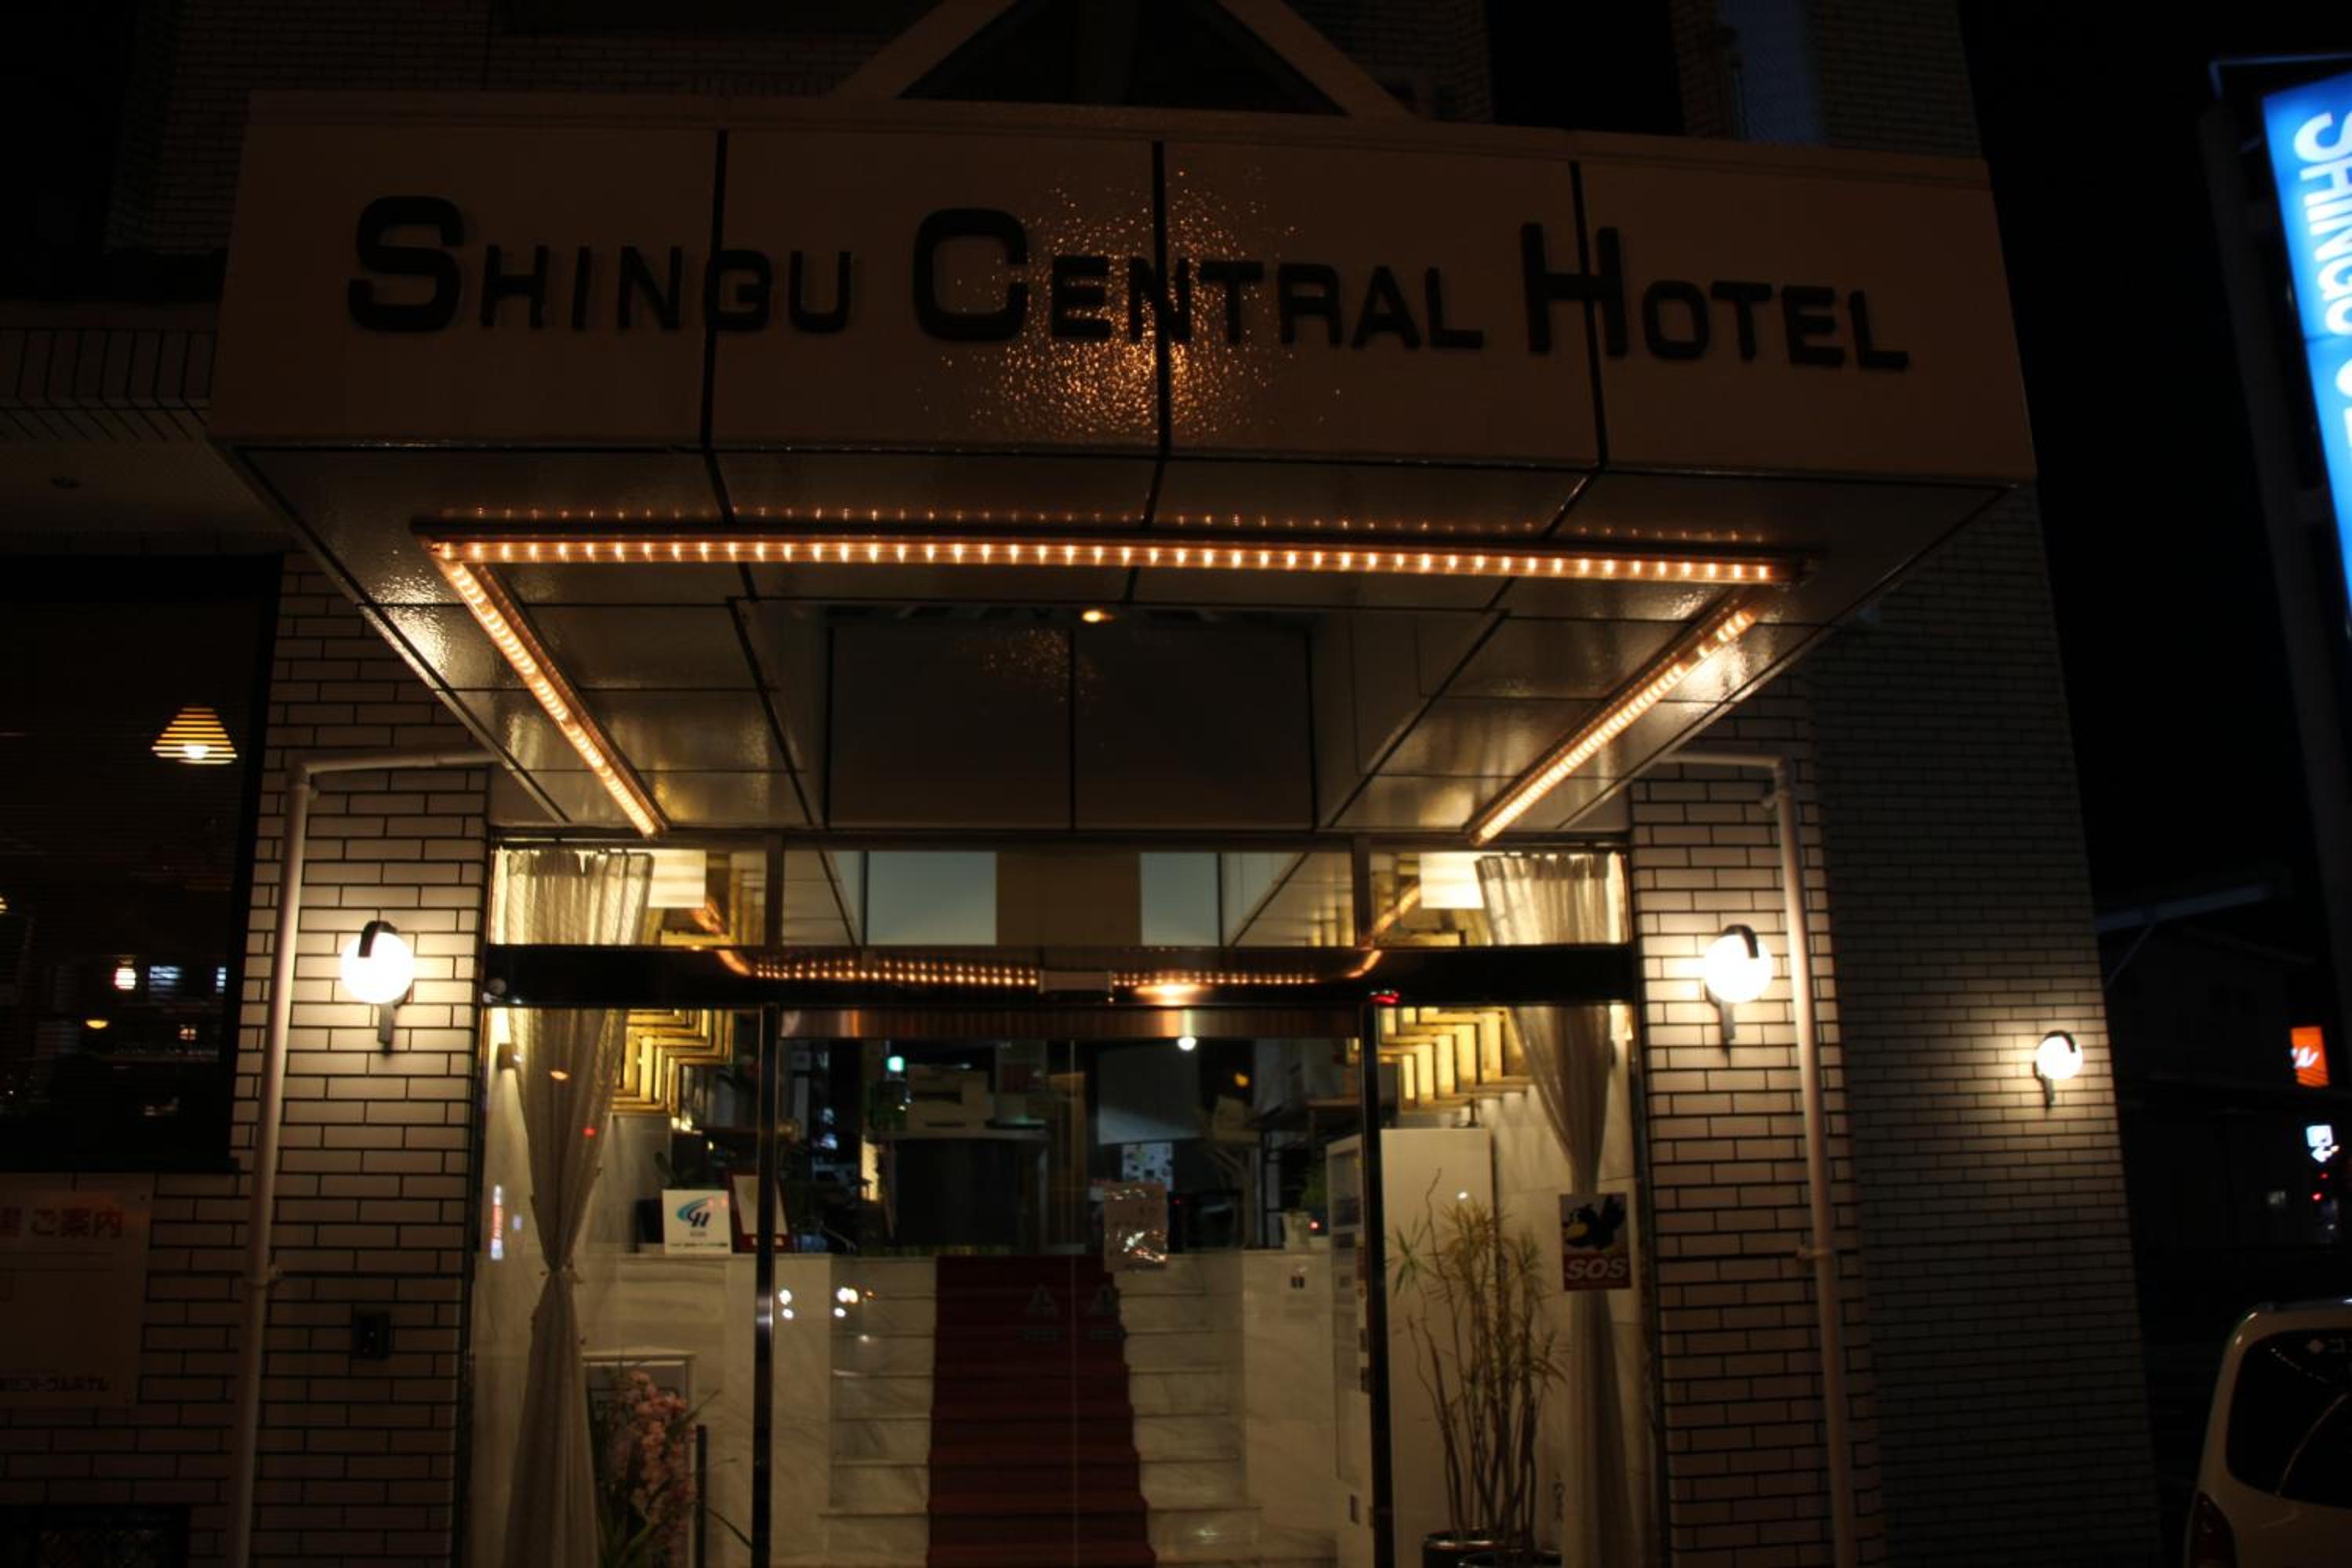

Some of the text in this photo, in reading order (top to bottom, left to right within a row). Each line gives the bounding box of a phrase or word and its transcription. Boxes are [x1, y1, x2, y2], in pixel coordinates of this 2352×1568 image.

[349, 195, 1910, 370] SHINGU CENTRAL HOTEL
[1566, 1256, 1628, 1280] SOS
